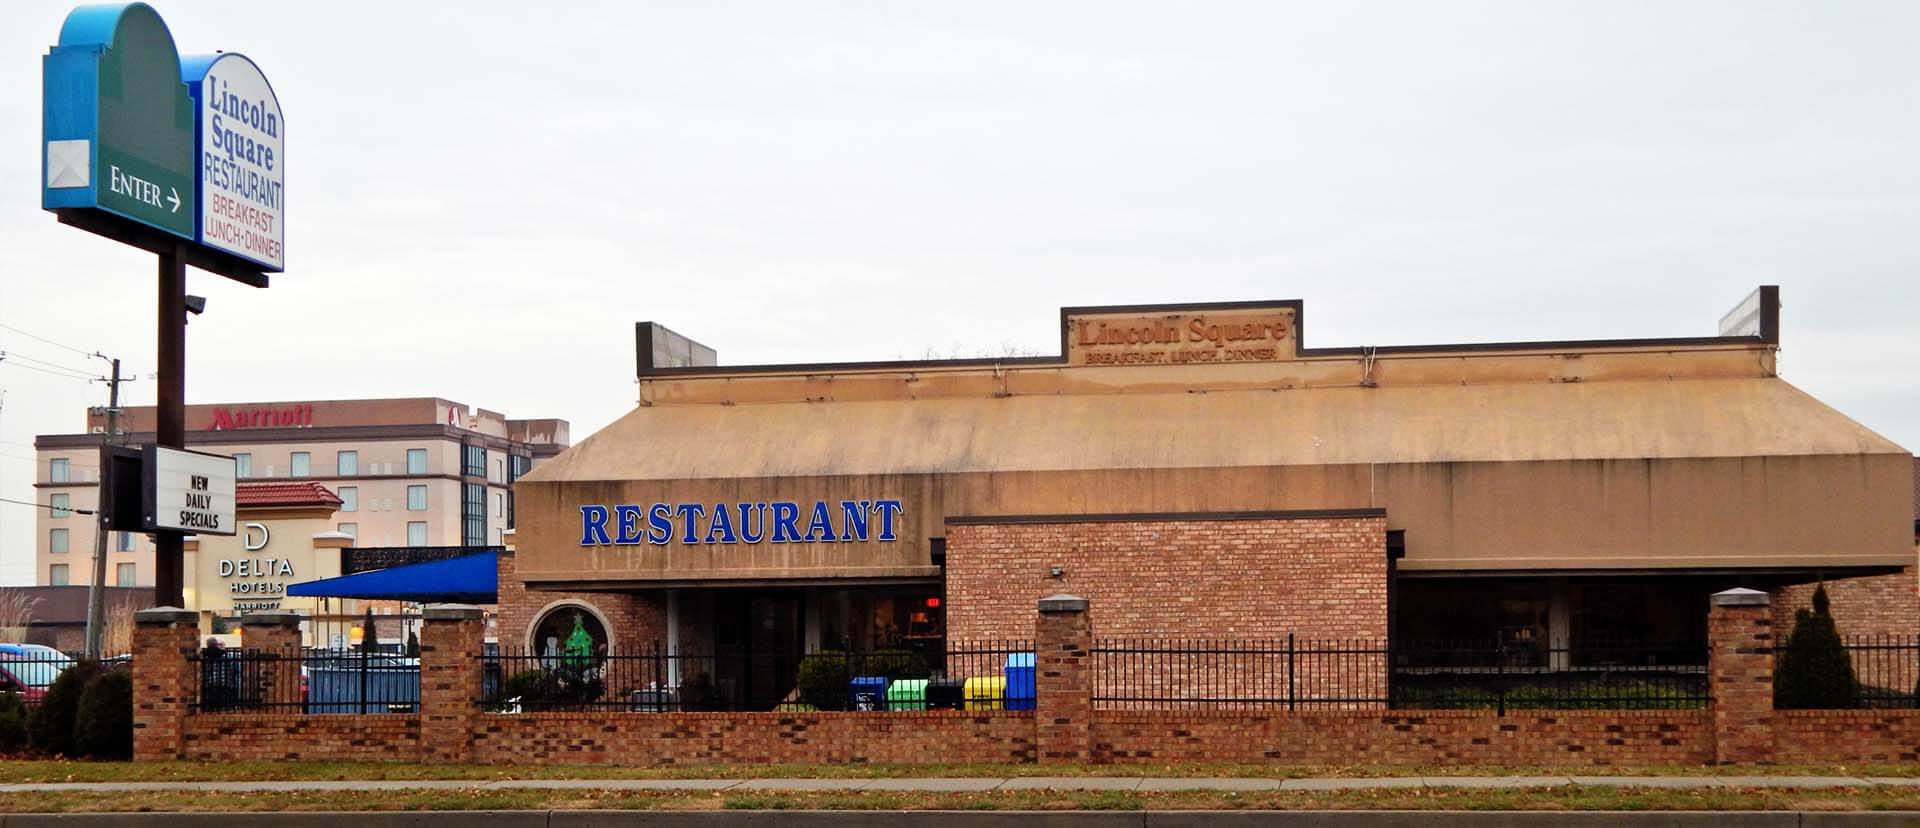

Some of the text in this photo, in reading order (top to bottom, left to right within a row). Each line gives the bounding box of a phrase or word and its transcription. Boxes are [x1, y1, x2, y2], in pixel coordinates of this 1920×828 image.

[209, 74, 277, 139] Lincoln
[212, 113, 274, 171] Square
[205, 151, 281, 211] RESTAURANT
[213, 193, 274, 234] BREAKFAST
[1077, 317, 1287, 347] Lincoln Square
[1224, 348, 1277, 361] DINNER
[209, 404, 312, 431] Marriott
[191, 475, 209, 491] NEW
[186, 493, 211, 510] DAILY
[179, 510, 219, 529] SPECIALS
[579, 500, 903, 546] RESTAURANT
[219, 559, 294, 577] DELTA
[231, 582, 284, 593] HOTELS
